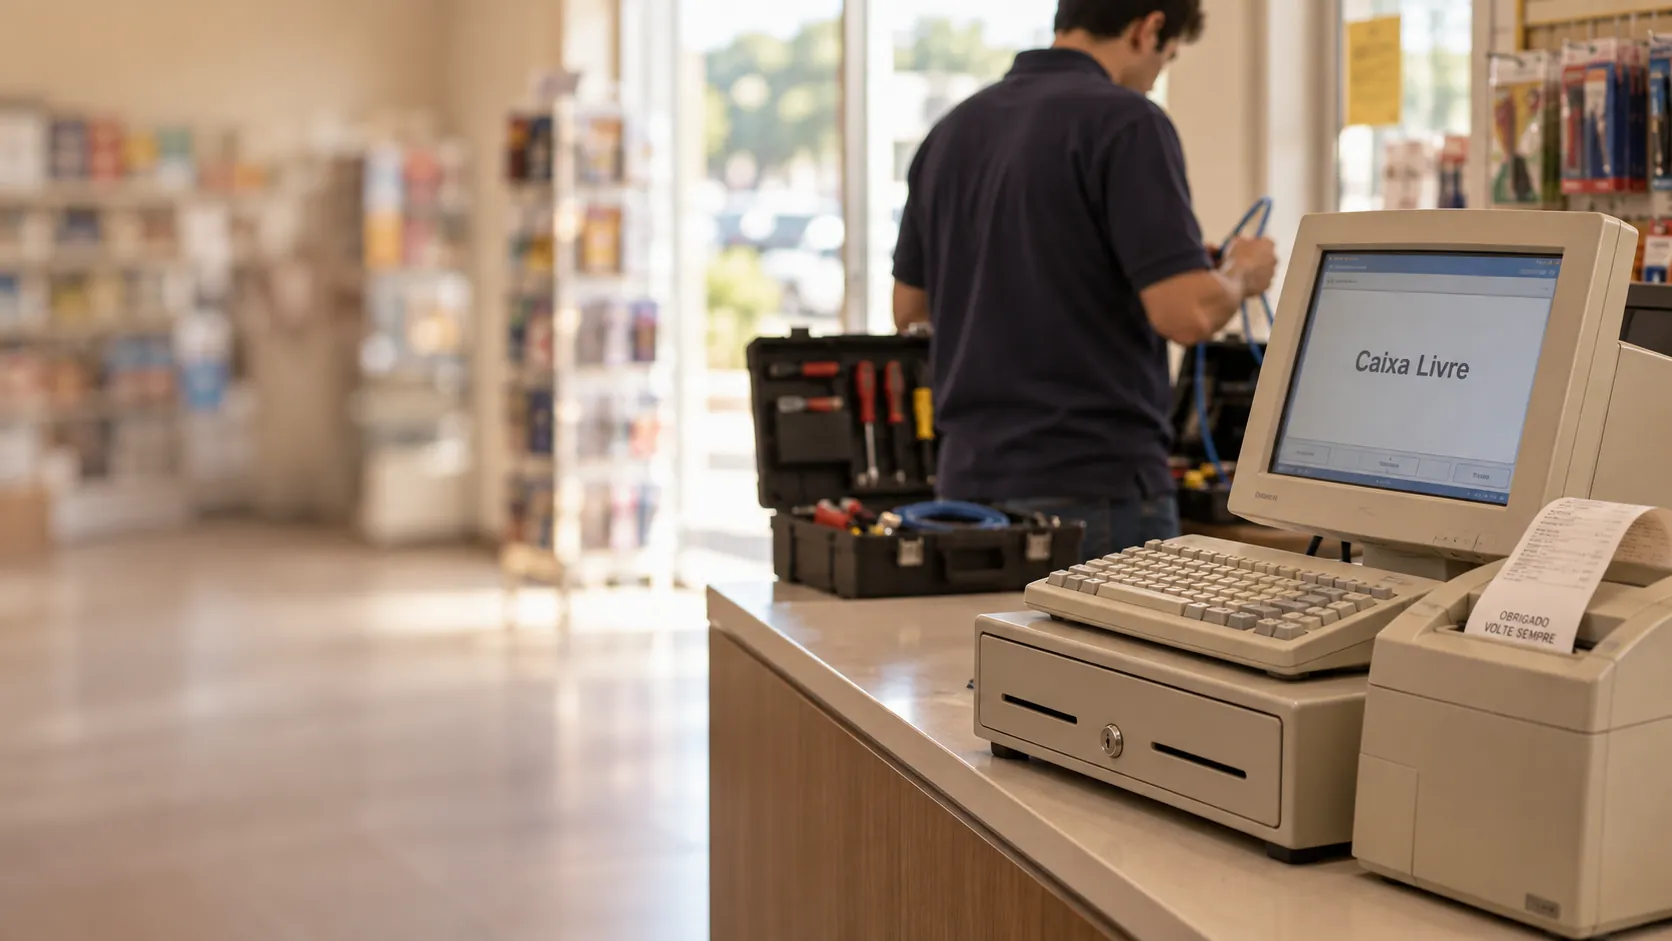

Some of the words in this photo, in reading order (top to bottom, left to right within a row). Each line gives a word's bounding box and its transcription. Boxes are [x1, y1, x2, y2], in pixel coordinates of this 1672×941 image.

[1355, 350, 1410, 375] Caixa
[1416, 354, 1470, 380] Livre
[1499, 610, 1550, 628] OBRIGADO
[1484, 622, 1515, 637] VOLTE
[1515, 628, 1557, 645] SEMPRE
